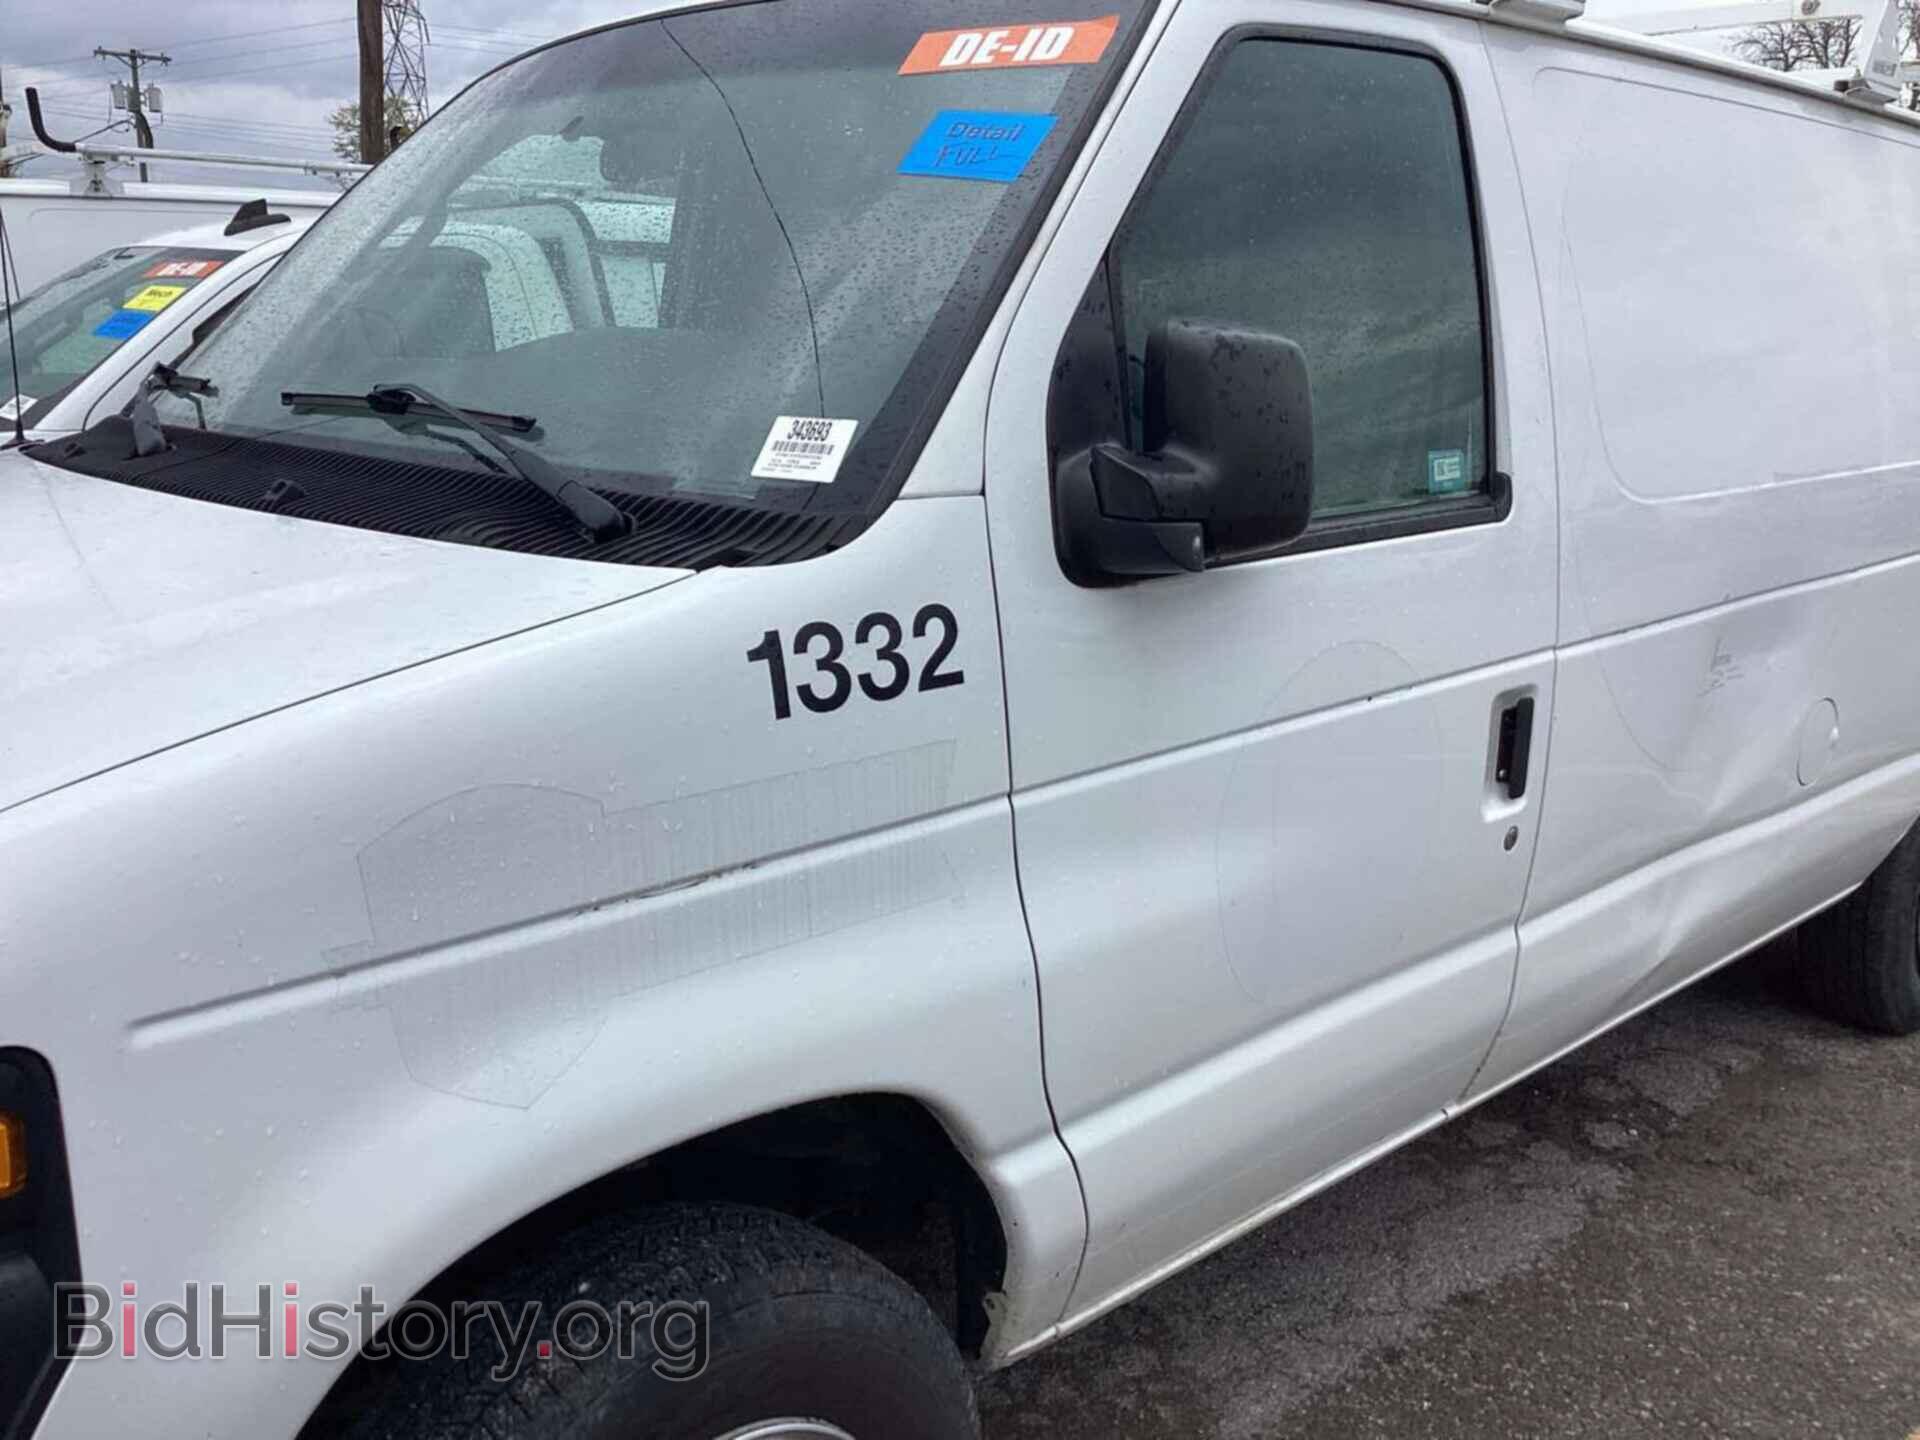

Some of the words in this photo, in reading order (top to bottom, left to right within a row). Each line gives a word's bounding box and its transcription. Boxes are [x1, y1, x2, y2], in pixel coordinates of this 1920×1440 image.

[939, 26, 1075, 67] DE-ID
[947, 121, 1025, 142] Detail
[787, 419, 833, 442] 343693
[746, 603, 965, 720] 1332
